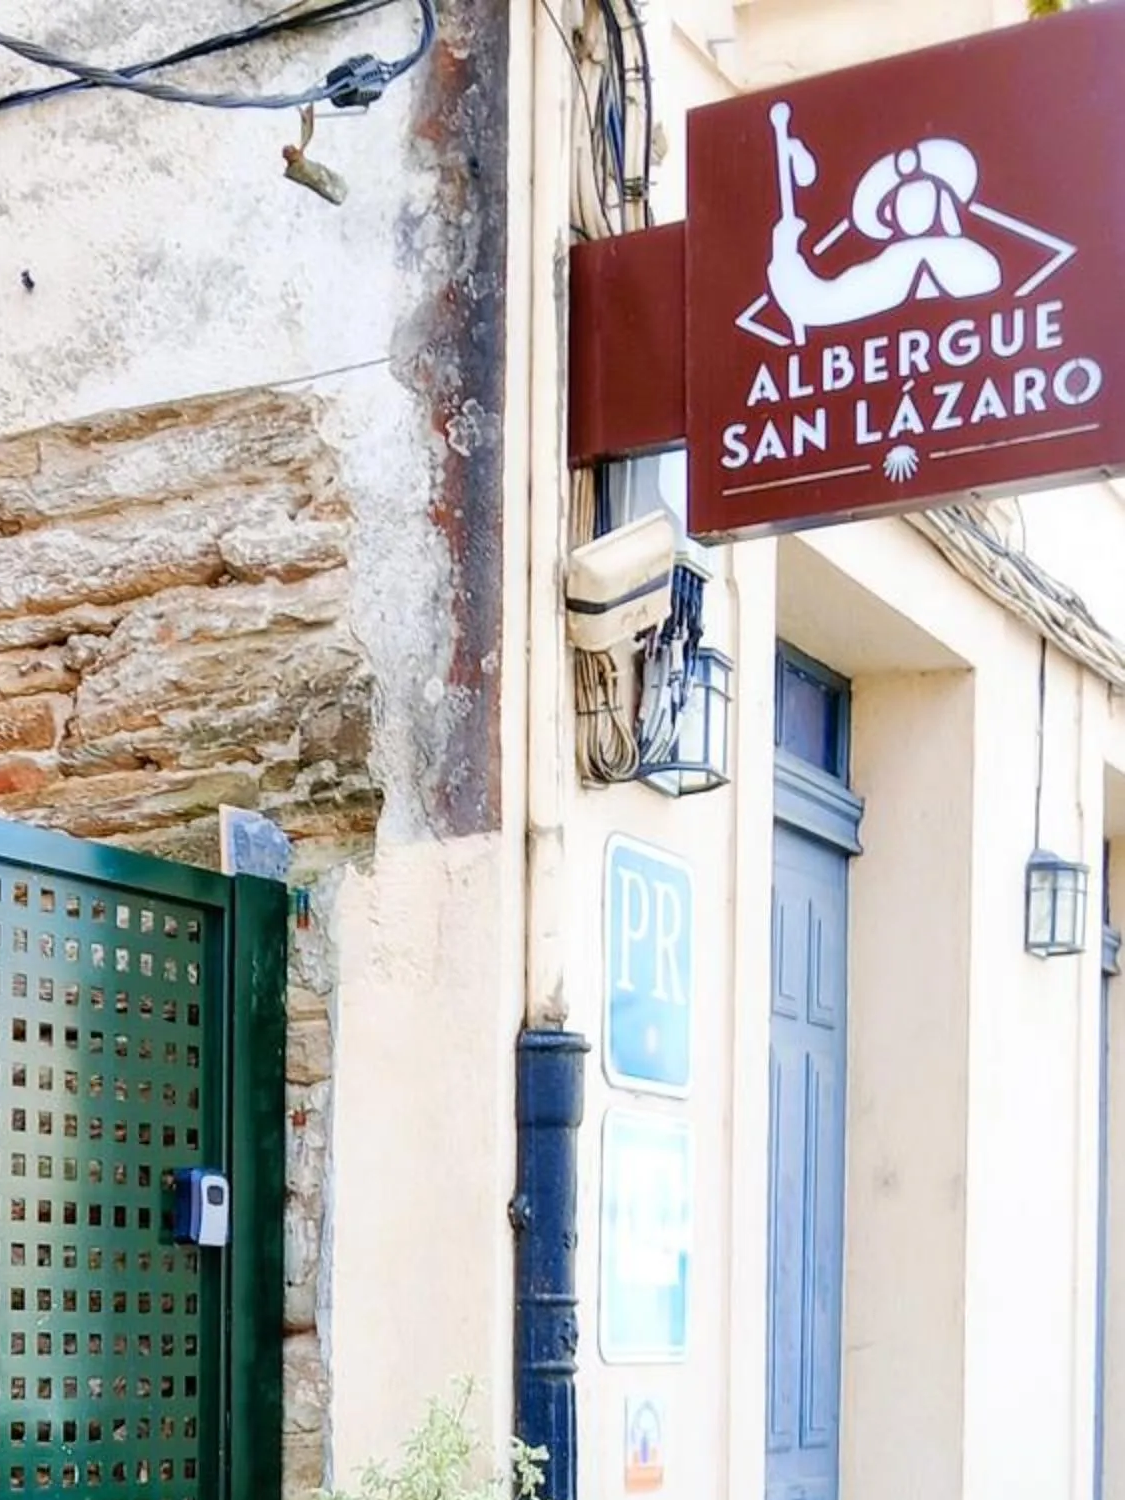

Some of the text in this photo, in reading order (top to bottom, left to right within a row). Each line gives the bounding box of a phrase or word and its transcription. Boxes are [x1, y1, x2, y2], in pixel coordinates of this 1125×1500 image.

[747, 301, 1064, 406] ALBERGUE
[721, 357, 1103, 469] SAN LÁZARO
[617, 868, 686, 1004] PR
